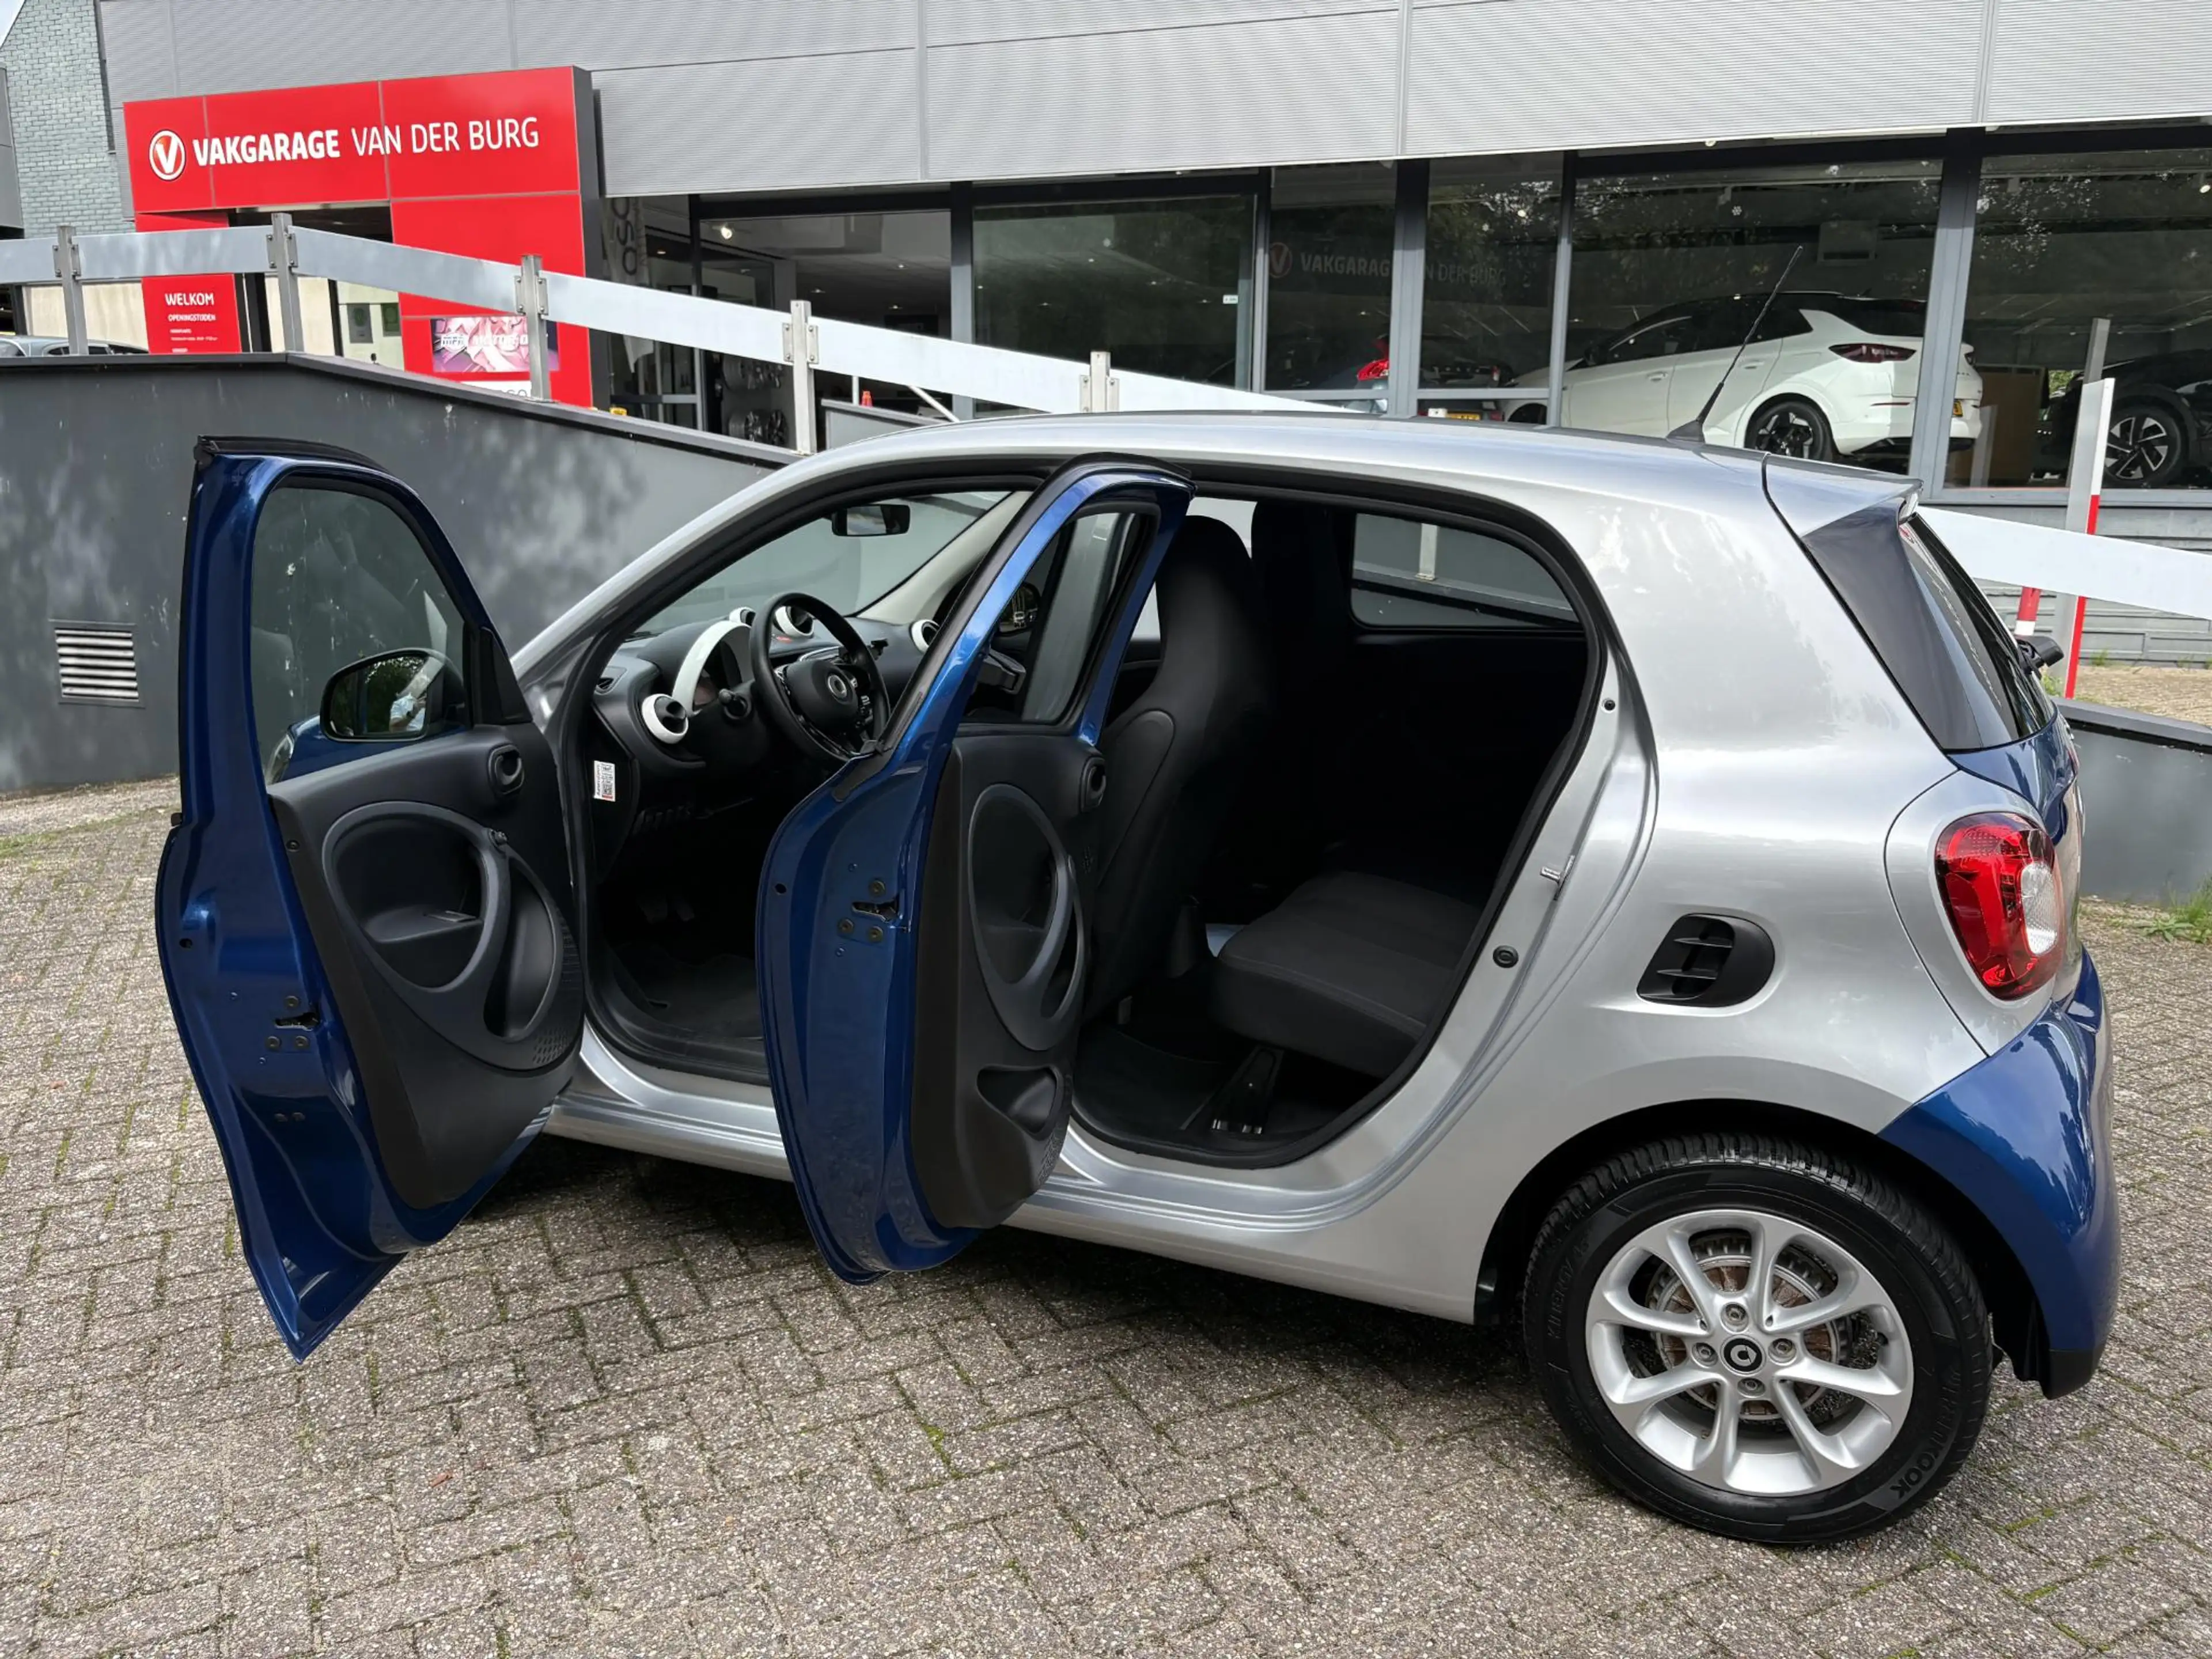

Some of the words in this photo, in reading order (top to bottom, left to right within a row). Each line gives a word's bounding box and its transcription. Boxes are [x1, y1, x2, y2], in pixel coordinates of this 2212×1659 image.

[192, 129, 340, 166] VAKGARAGE
[351, 124, 402, 157] VAN
[411, 122, 460, 154] DER
[468, 116, 540, 151] BURG
[1300, 252, 1391, 278] VAKGARAG
[165, 292, 215, 306] WELKOM
